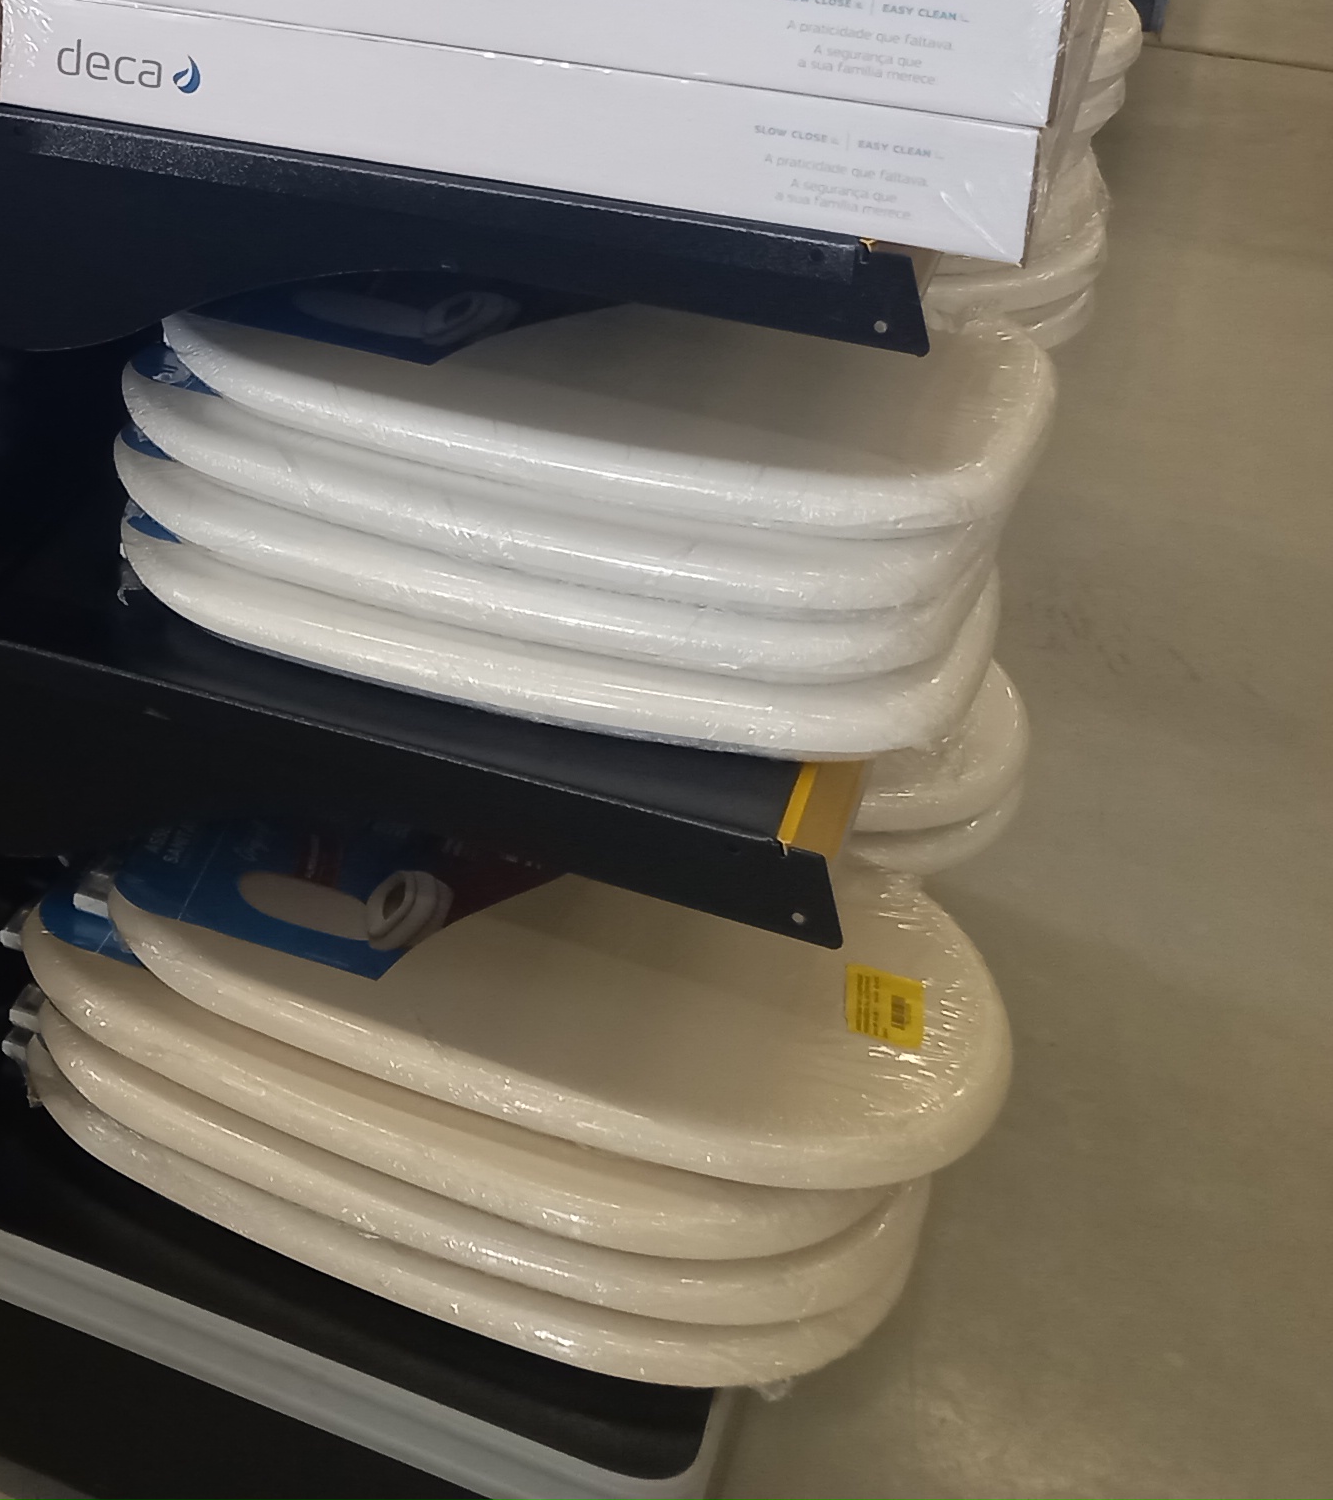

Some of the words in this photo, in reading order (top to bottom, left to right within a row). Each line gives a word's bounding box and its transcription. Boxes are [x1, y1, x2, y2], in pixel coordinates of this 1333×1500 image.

[882, 4, 914, 15] EASY
[918, 8, 957, 21] CLEAN
[57, 38, 163, 89] deca
[754, 125, 787, 136] SLOW
[791, 130, 827, 143] CLOSE
[858, 139, 888, 151] EASY
[893, 144, 931, 158] CLEAN
